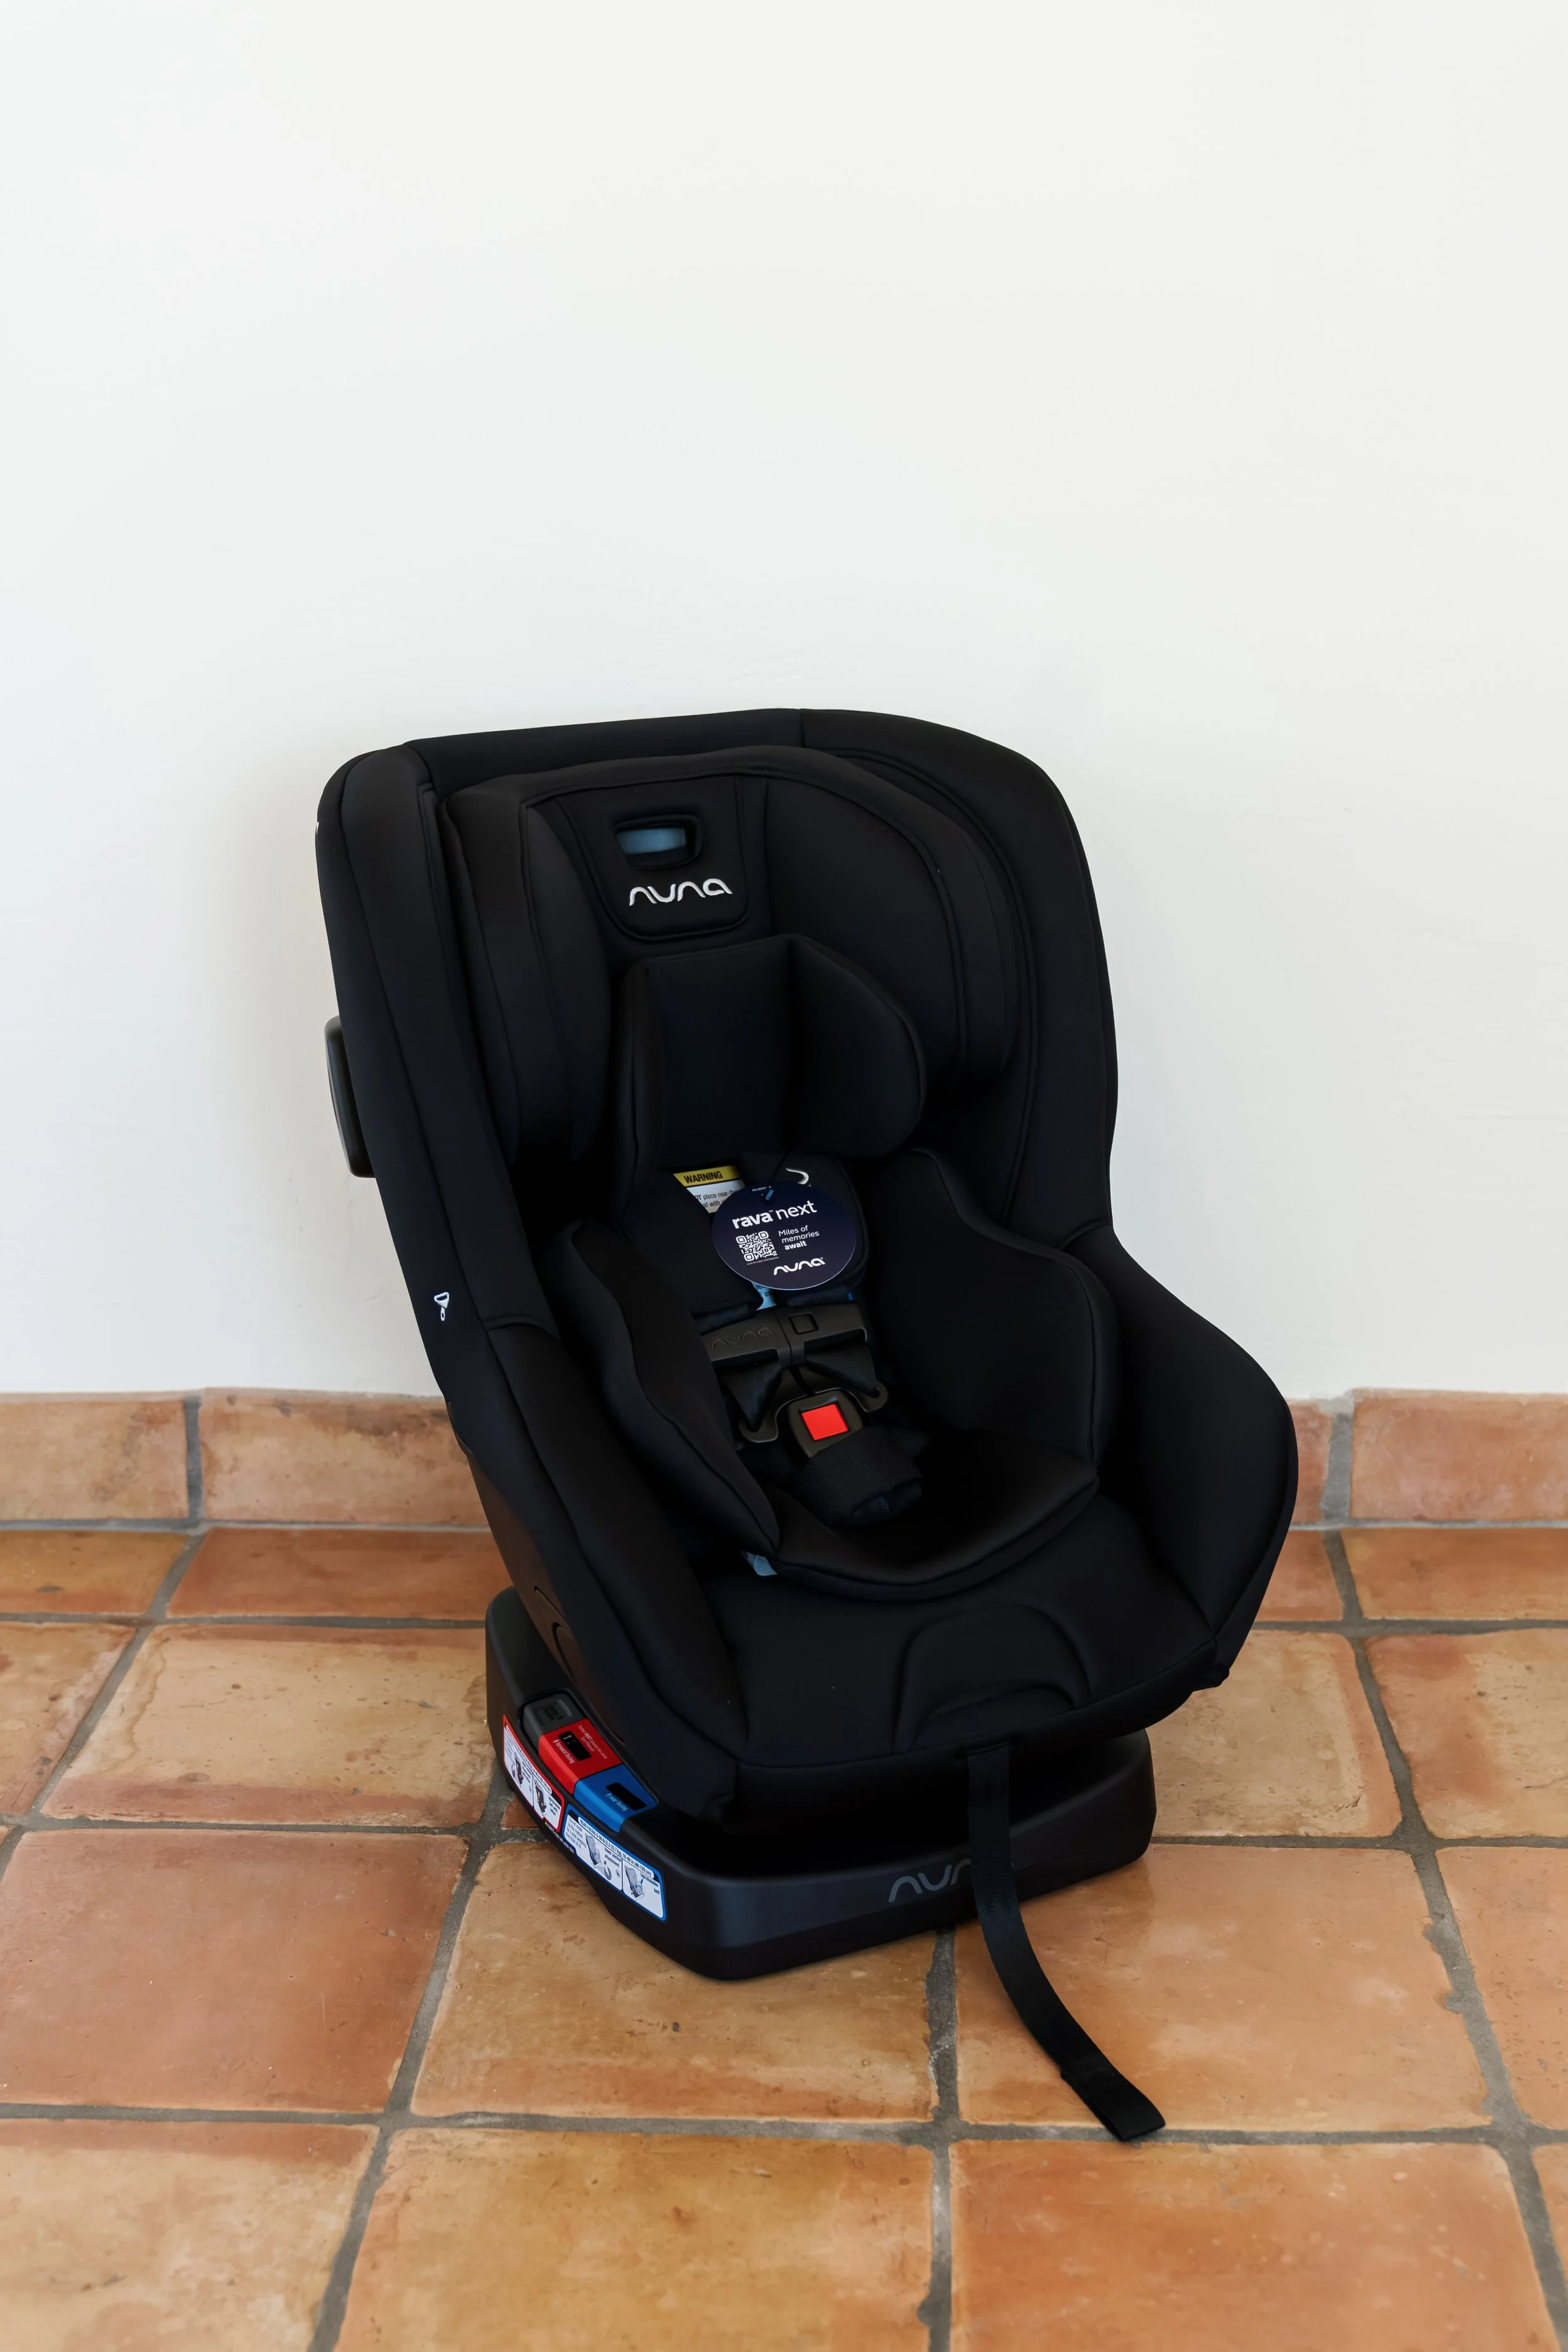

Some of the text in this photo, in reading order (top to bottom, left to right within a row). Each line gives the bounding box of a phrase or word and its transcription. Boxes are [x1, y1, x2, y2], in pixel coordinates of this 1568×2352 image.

[629, 878, 733, 906] nuna
[684, 1171, 723, 1184] WARNING
[775, 1200, 817, 1220] next
[778, 1228, 799, 1236] Miles
[781, 1231, 820, 1243] memories
[785, 1241, 807, 1250] await
